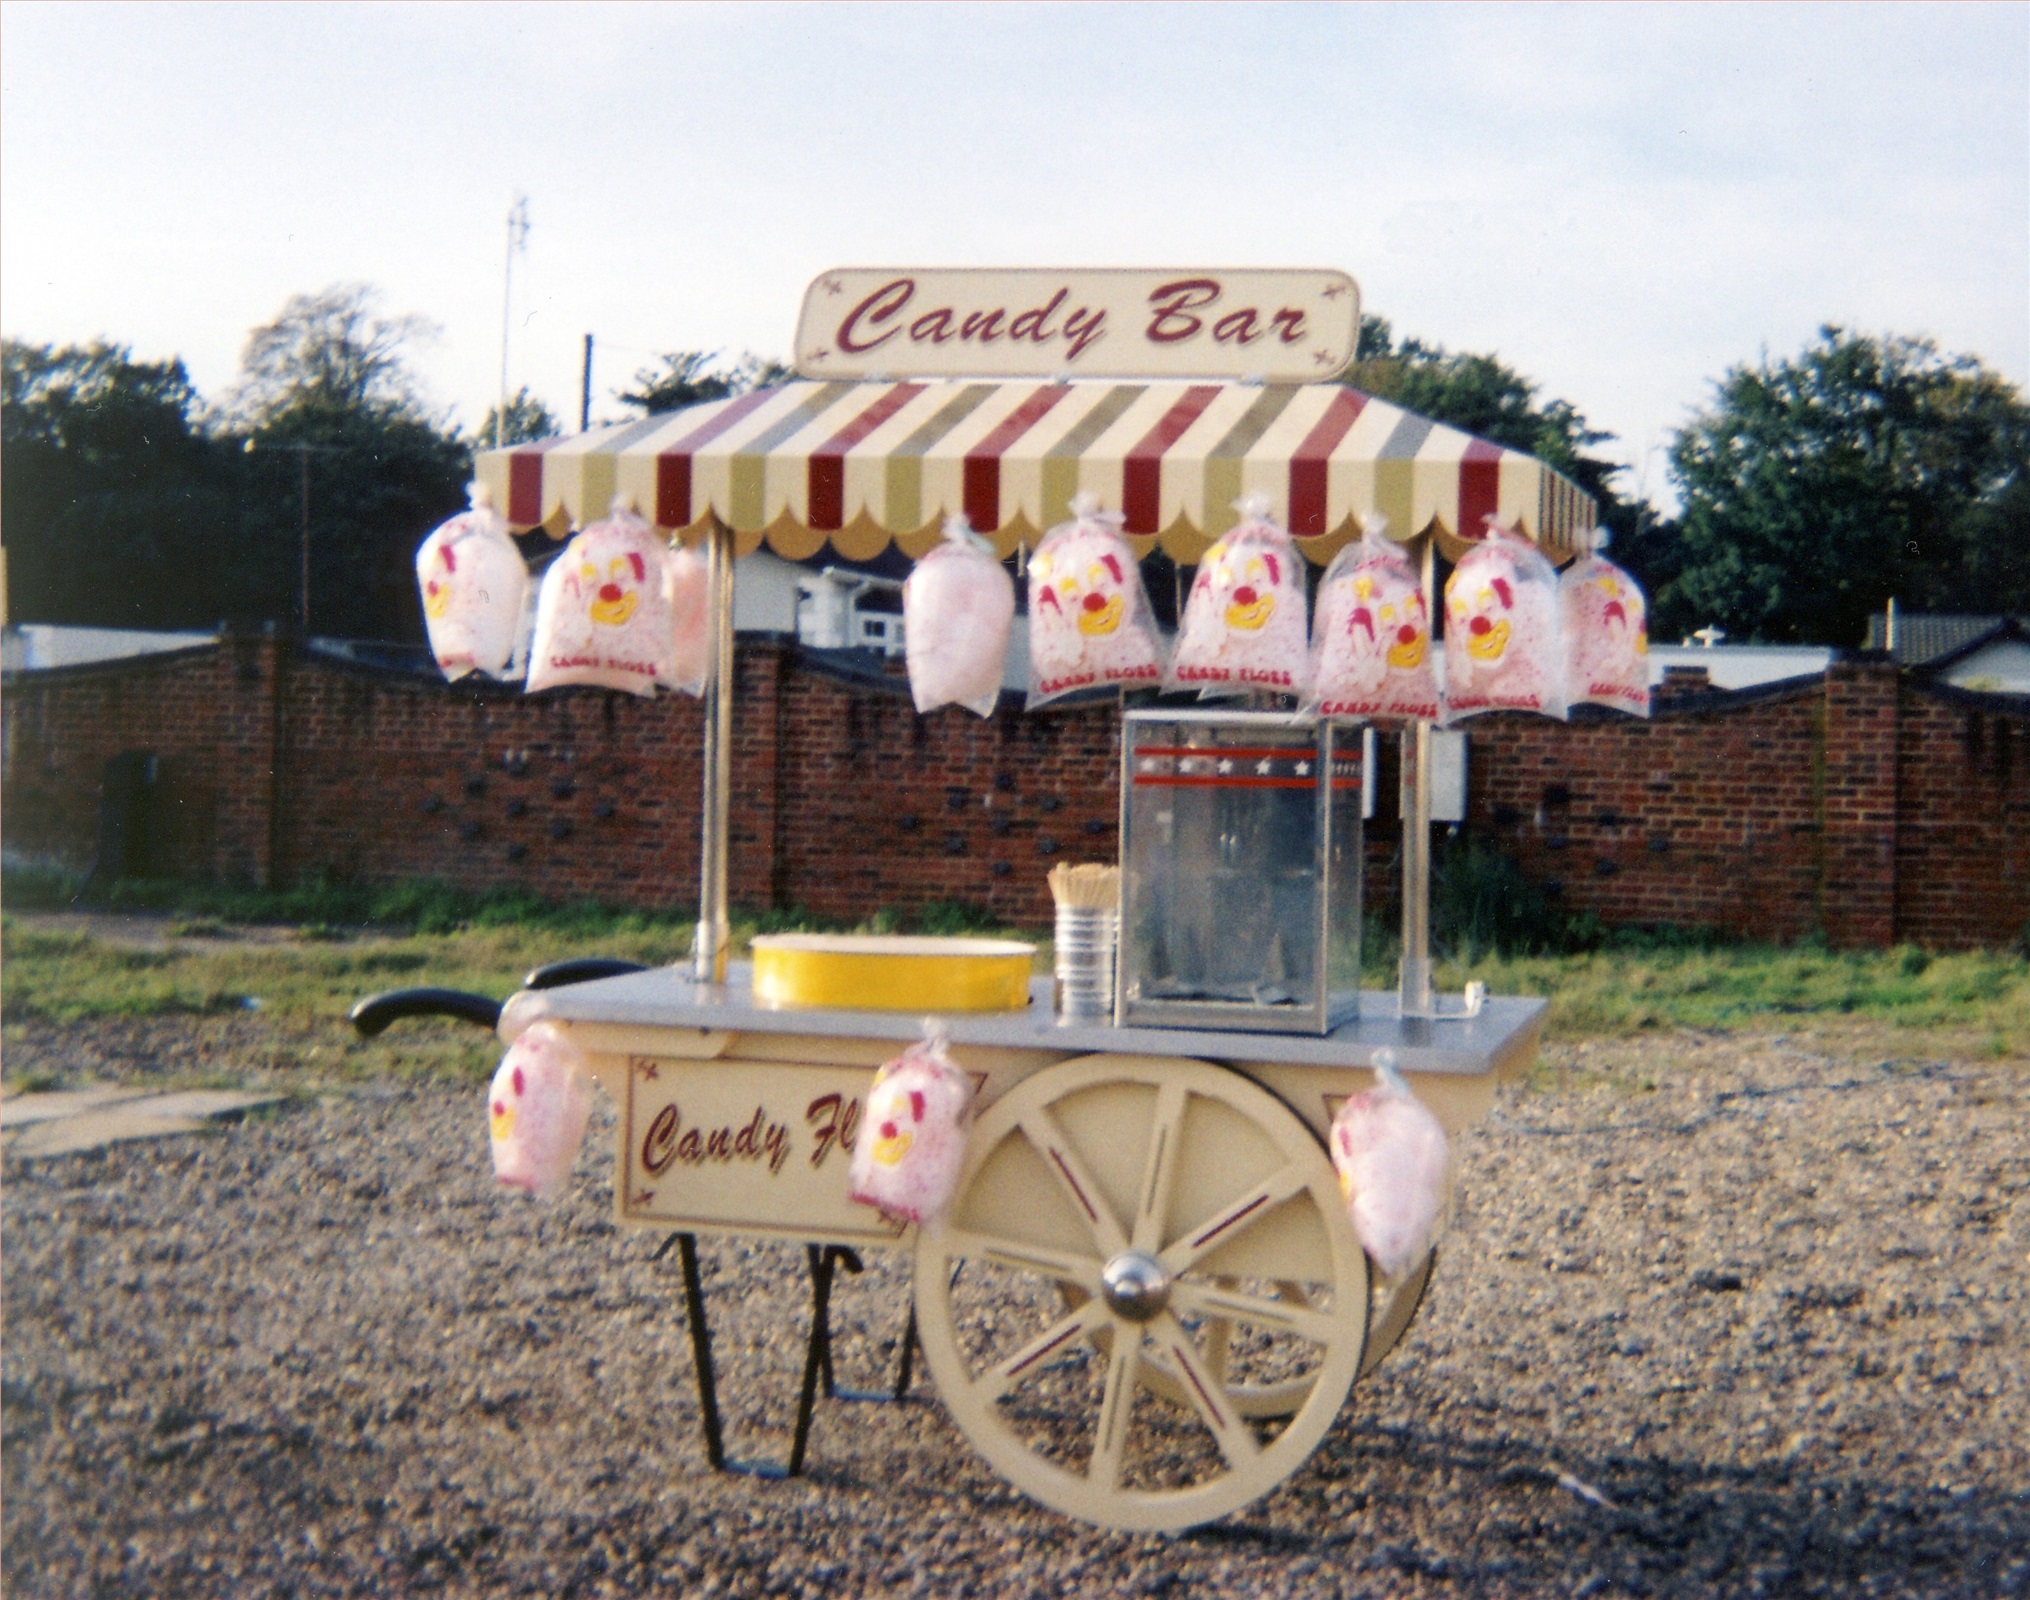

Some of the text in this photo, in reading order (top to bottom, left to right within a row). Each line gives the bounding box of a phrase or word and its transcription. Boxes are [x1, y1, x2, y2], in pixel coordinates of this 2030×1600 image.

[835, 278, 1307, 361] Candy Bar
[641, 1102, 788, 1174] Candy
